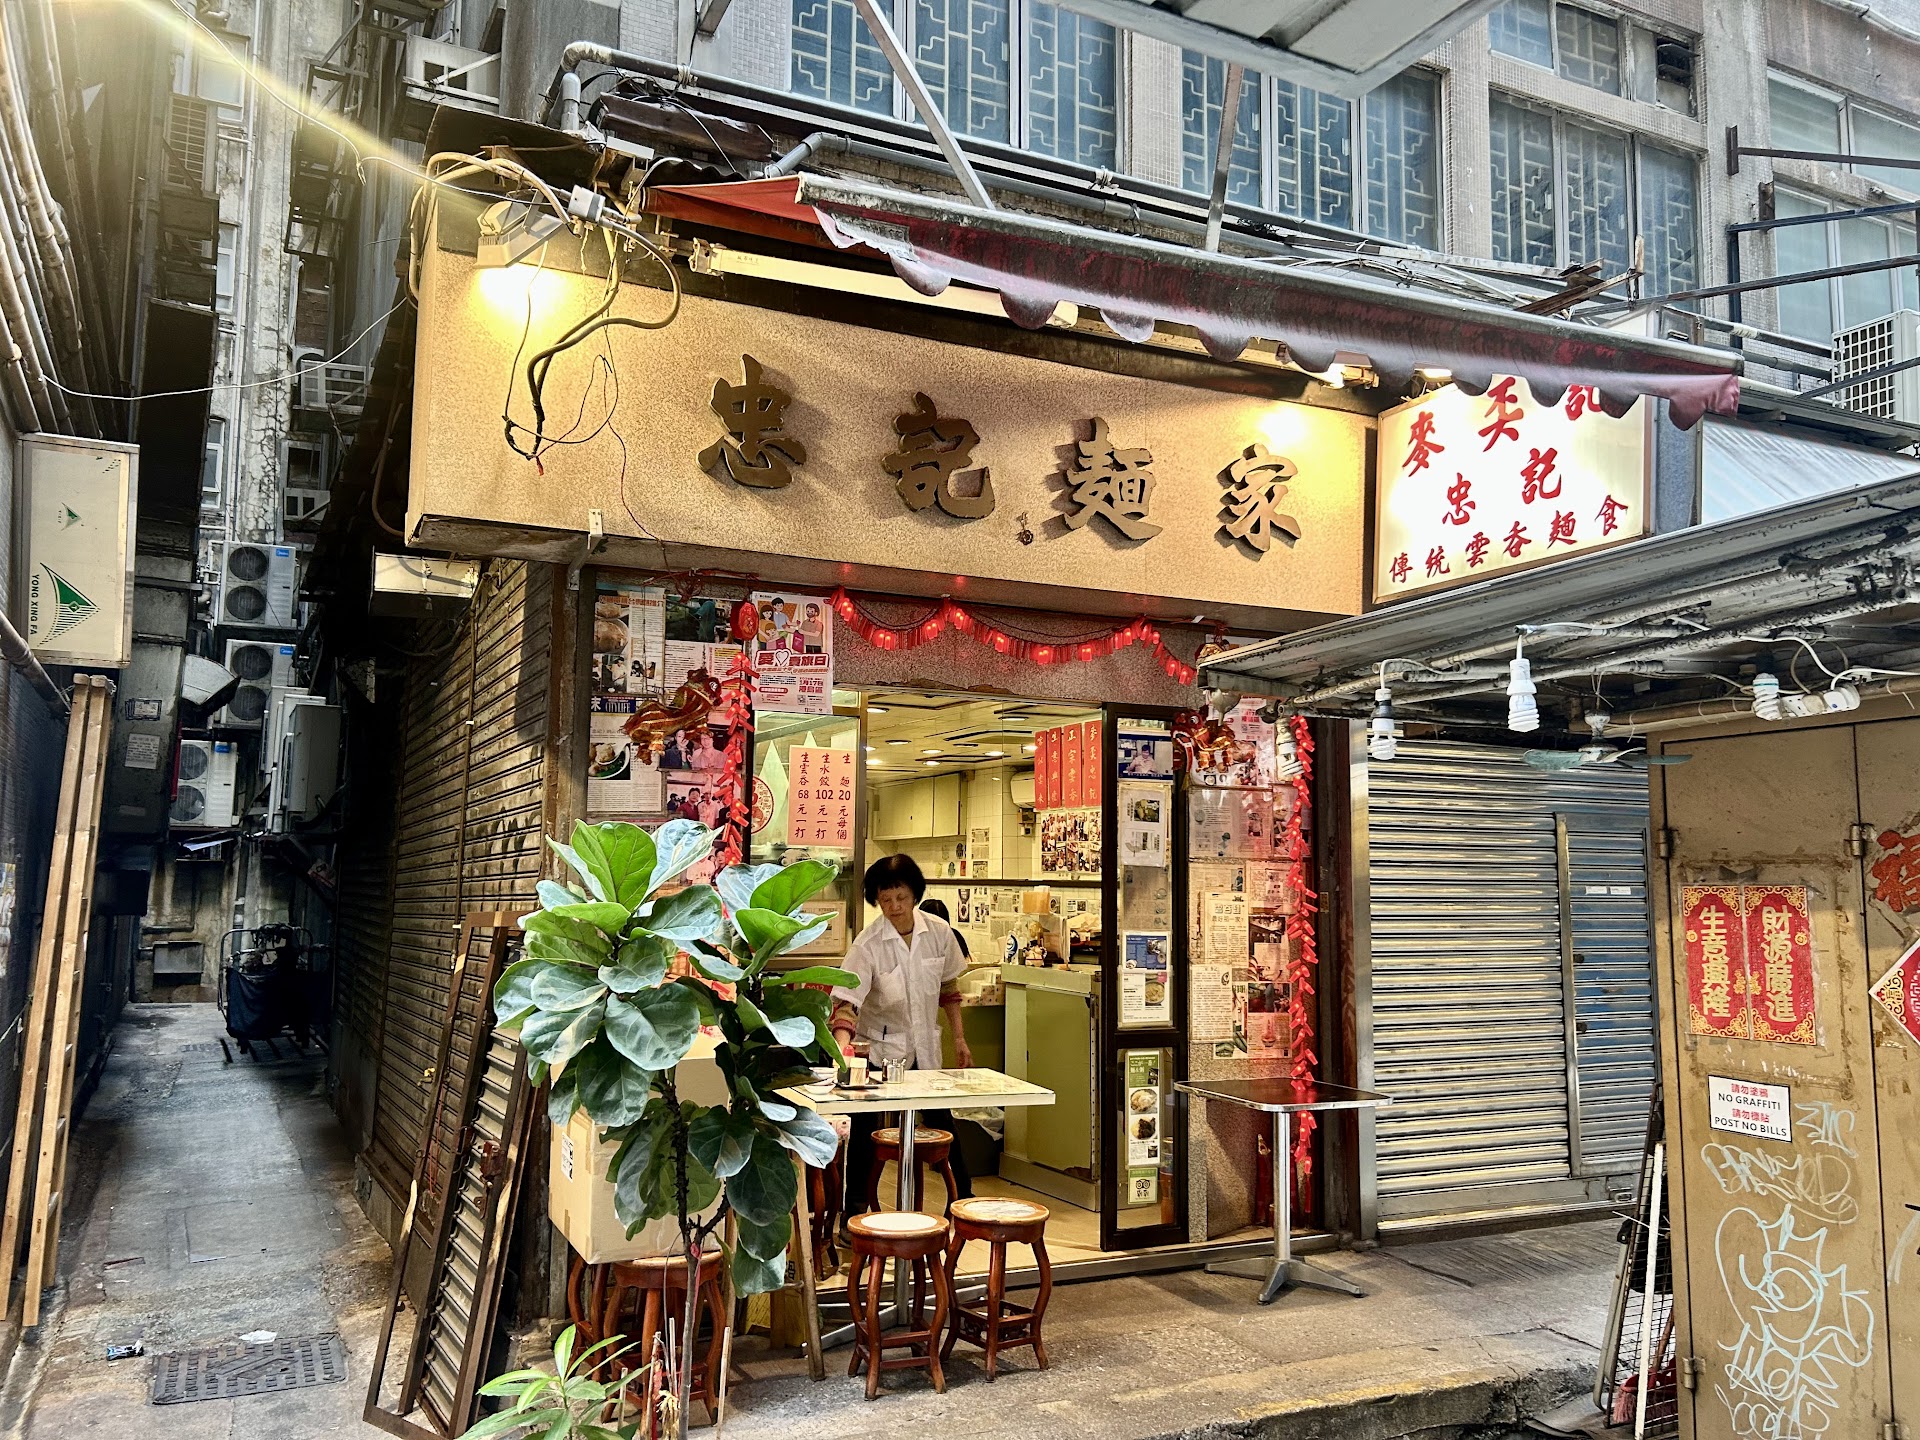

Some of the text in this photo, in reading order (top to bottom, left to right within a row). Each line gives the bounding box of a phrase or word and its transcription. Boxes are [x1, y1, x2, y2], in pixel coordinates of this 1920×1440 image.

[698, 354, 1301, 551] 忠記麵家
[1442, 448, 1561, 525] 忠記
[1389, 495, 1628, 583] 傳統雲吞麵食
[29, 574, 40, 635] YONG XING FA
[1699, 905, 1731, 1018] 生意興隆
[1761, 905, 1797, 1022] 財源廣進
[1714, 1116, 1787, 1136] POST NO BILLS
[1718, 1093, 1781, 1110] NO GRAFFITI
